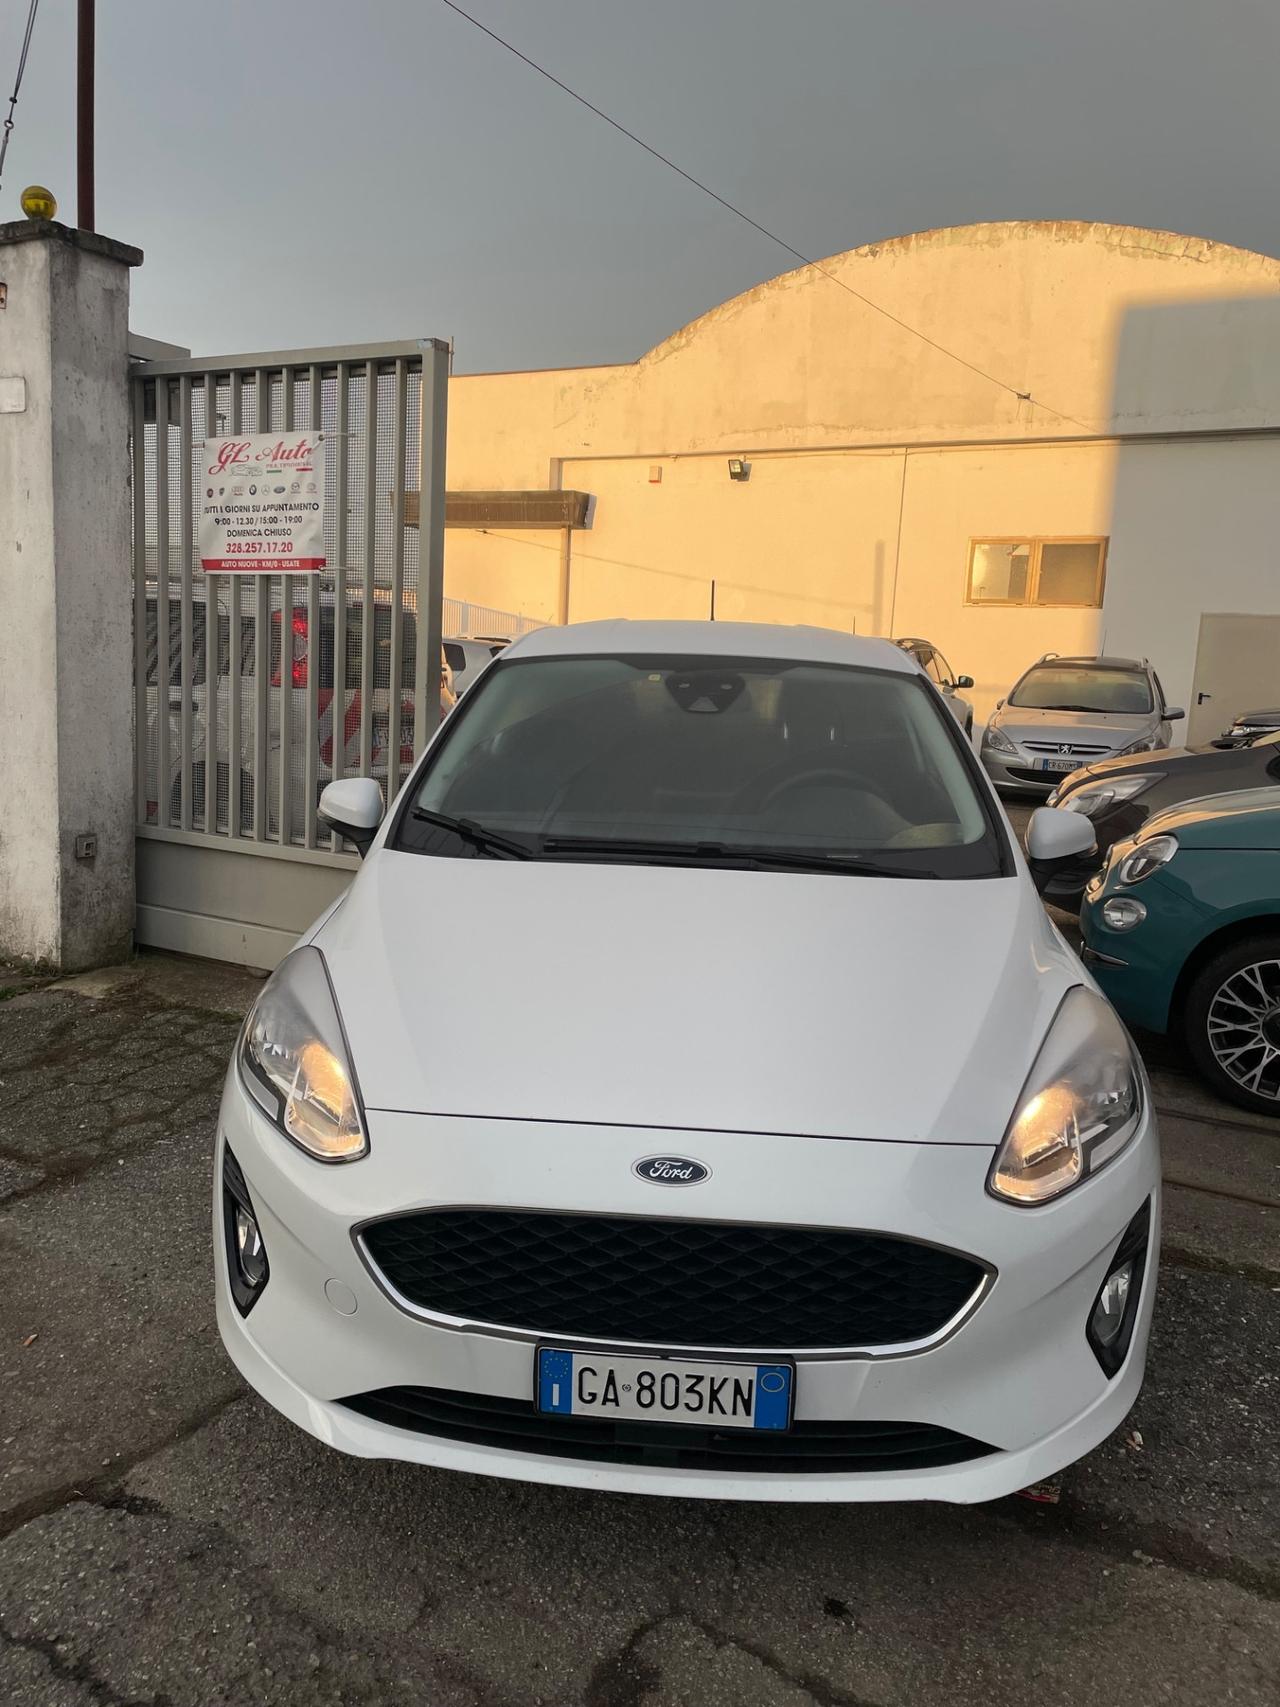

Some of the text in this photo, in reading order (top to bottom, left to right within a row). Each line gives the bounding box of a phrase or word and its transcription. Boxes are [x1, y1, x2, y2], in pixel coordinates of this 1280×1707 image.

[204, 505, 219, 514] UTTI
[225, 505, 251, 514] GIORNI
[251, 504, 261, 512] SU
[262, 502, 320, 512] APPUNTAMENTO
[226, 528, 292, 538] DOMENICA CHIUSO
[225, 542, 293, 554] 328.257.17.20
[238, 560, 258, 568] NUOVE
[649, 1160, 694, 1179] Ford
